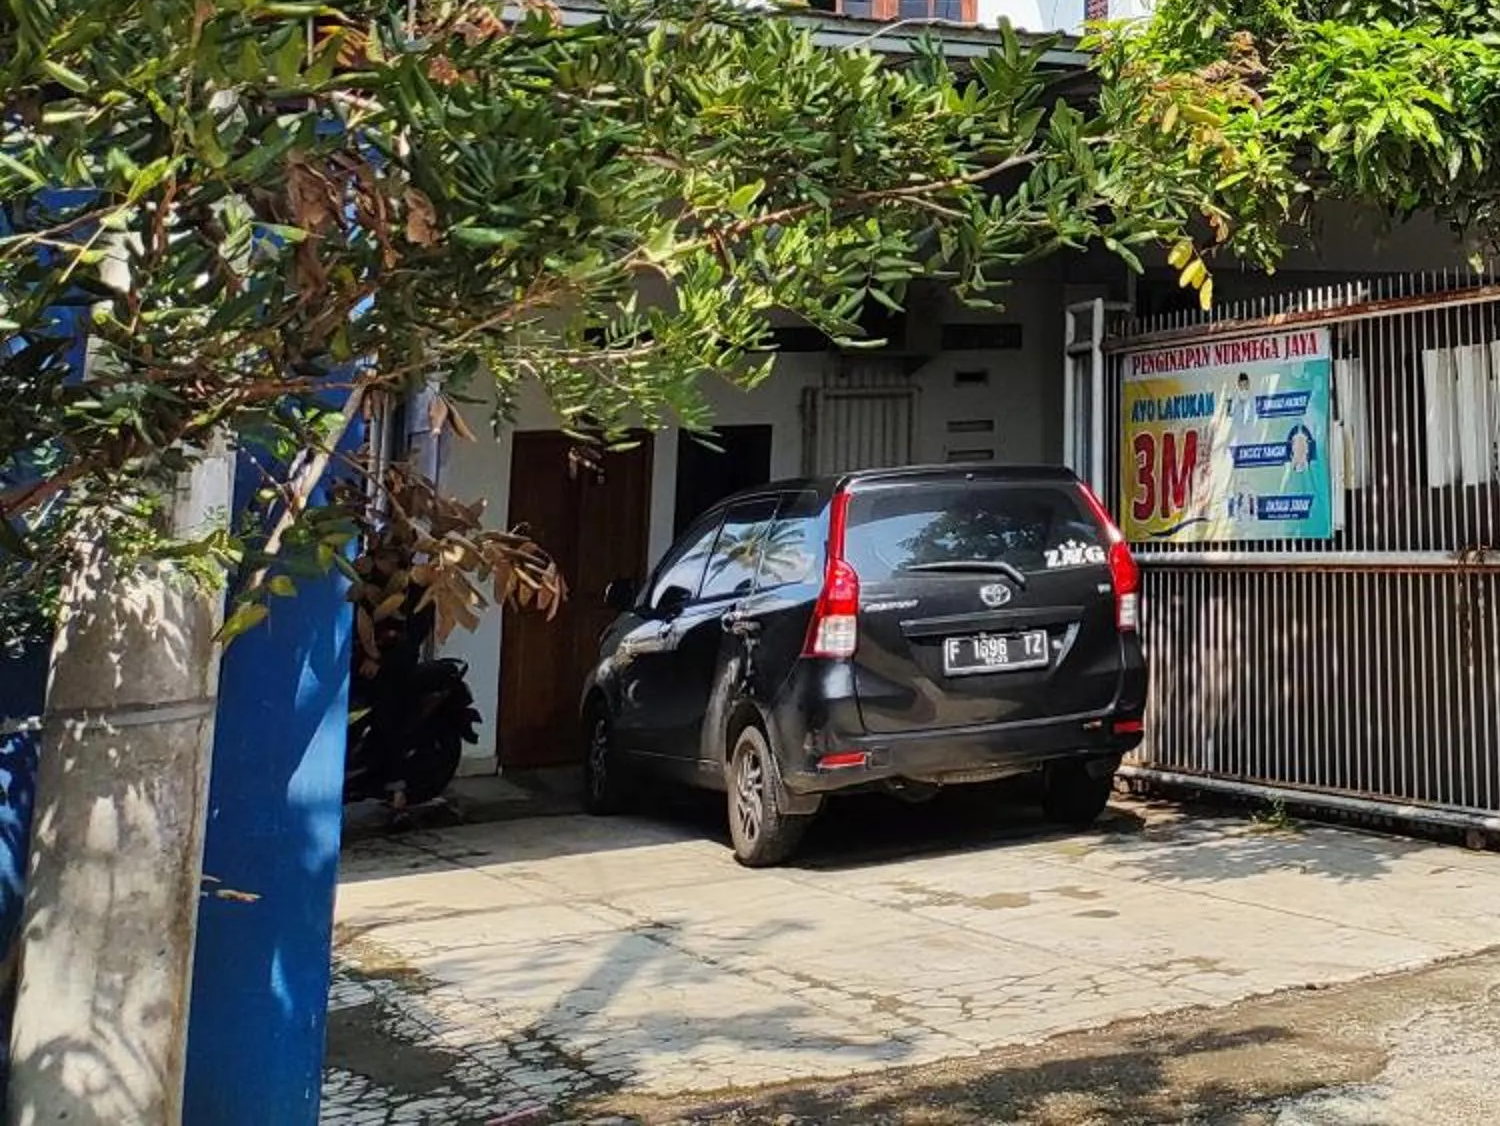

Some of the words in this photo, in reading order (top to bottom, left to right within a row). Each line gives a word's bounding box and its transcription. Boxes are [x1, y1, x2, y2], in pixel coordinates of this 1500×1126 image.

[1131, 345, 1211, 376] PENGINAPAN
[1214, 337, 1280, 366] NURMEGA
[1284, 331, 1317, 360] JAYA
[1131, 399, 1156, 423] AYO
[1157, 392, 1216, 421] LAKUKAN
[1132, 429, 1199, 521] 3M
[950, 641, 960, 662] F
[1023, 633, 1042, 655] TZ
